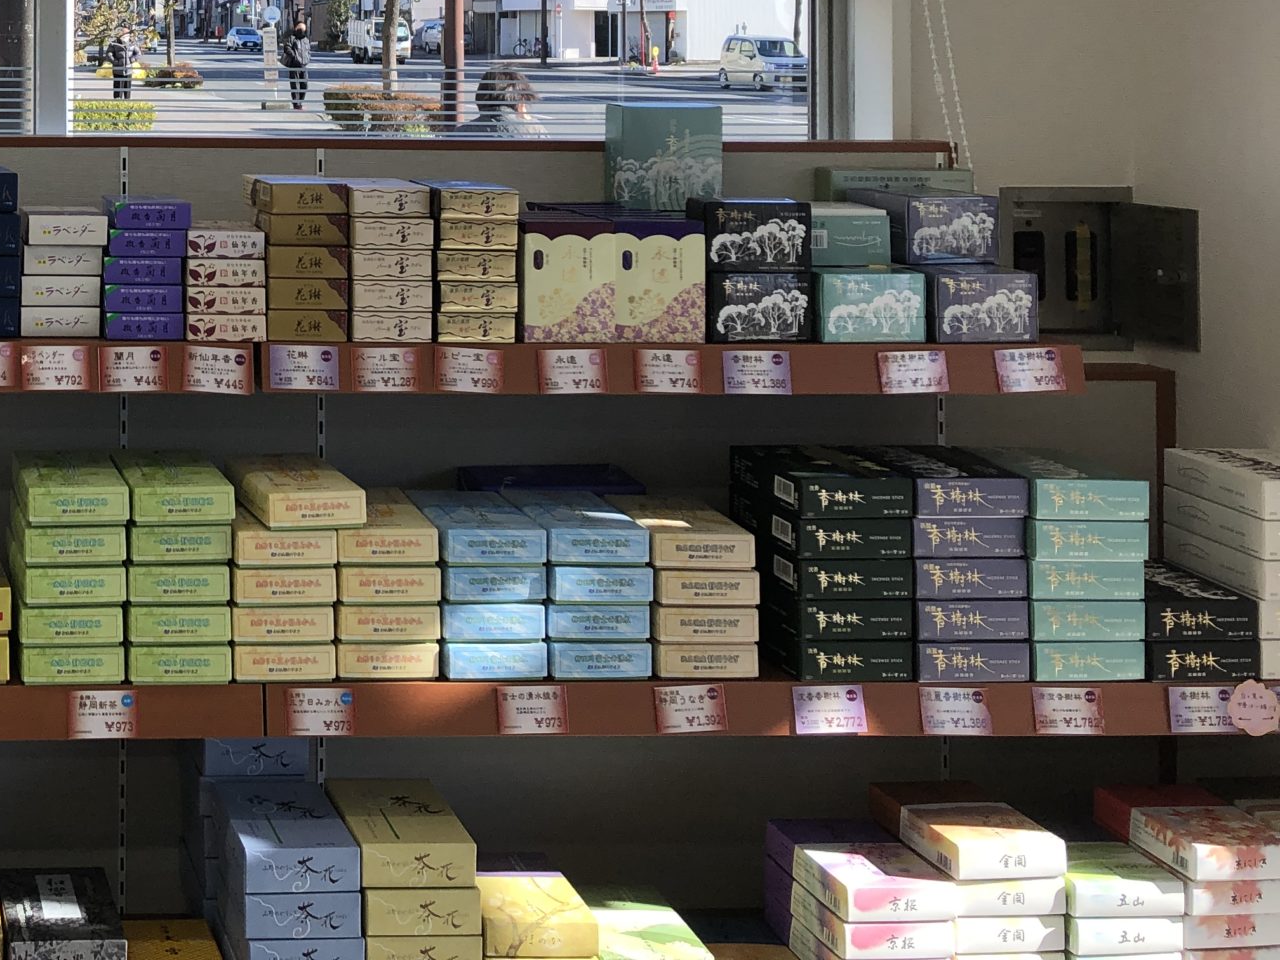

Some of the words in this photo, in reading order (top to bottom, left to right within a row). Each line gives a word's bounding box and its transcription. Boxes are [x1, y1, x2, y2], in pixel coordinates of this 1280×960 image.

[53, 223, 96, 236] ラベンダー
[48, 253, 91, 266] ラベンダー
[188, 352, 232, 364] 新仙年香
[286, 350, 308, 360] 花琳
[356, 354, 400, 362] パール宝
[440, 352, 484, 362] ルビー宝
[555, 354, 578, 364] 永遠
[651, 353, 672, 363] 永遠
[732, 354, 764, 364] 香樹林
[54, 375, 82, 386] ¥792
[134, 376, 164, 386] ¥445
[214, 378, 244, 390] ¥445
[306, 375, 335, 386] ¥841
[381, 376, 416, 388] ¥1,287
[470, 377, 498, 388] ¥990
[572, 378, 601, 389] ¥740
[670, 378, 698, 388] ¥740
[752, 378, 787, 388] ¥1,386
[818, 488, 866, 512] 香樹林
[815, 528, 864, 552] 香樹林
[816, 570, 866, 593] 香樹林
[816, 610, 865, 633] 香樹林
[816, 651, 865, 674] 香樹林
[1178, 692, 1211, 700] 香樹林
[78, 700, 118, 710] 静岡新茶
[324, 720, 352, 731] ¥973
[534, 717, 562, 728] ¥973
[686, 714, 722, 727] ¥1,392
[824, 716, 863, 728] ¥2,772
[1063, 717, 1099, 728] ¥1,782
[1199, 716, 1233, 726] ¥1,782
[105, 722, 134, 732] ¥973
[252, 743, 290, 768] 茶花
[297, 856, 342, 884] 茶花
[414, 852, 456, 881] 茶花
[1118, 894, 1144, 907] 五山
[298, 902, 343, 930] 茶花
[420, 901, 463, 930] 茶花
[1118, 930, 1145, 944] 五山
